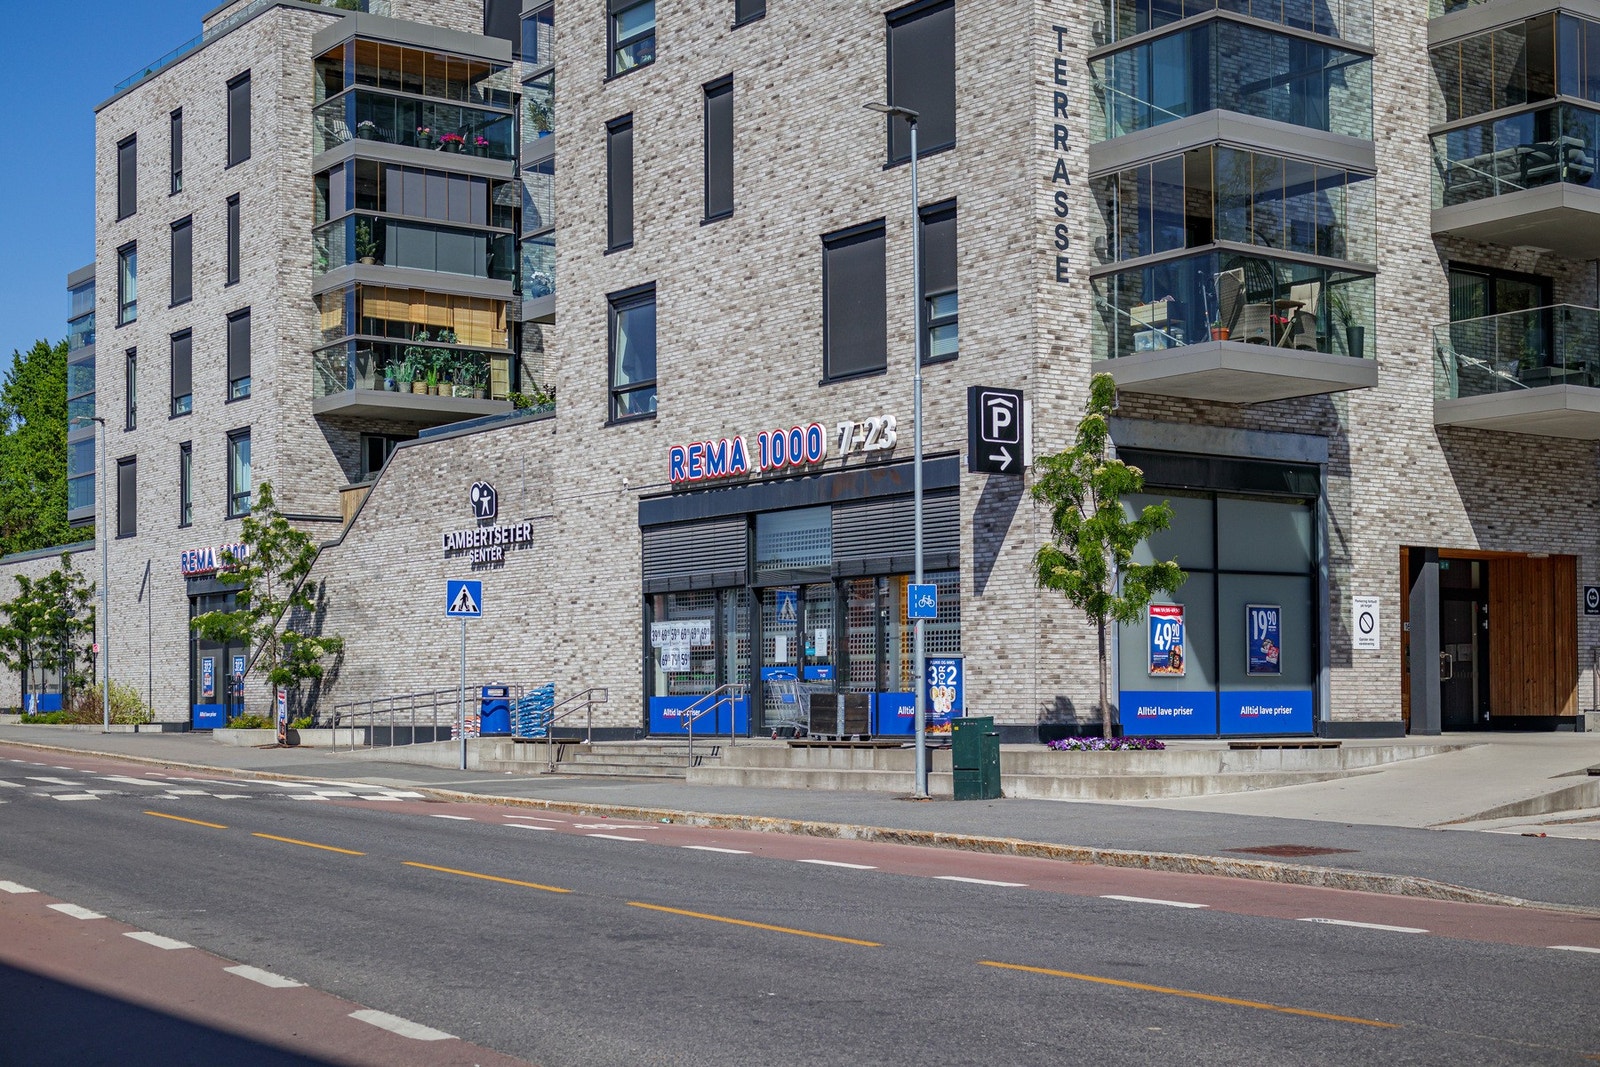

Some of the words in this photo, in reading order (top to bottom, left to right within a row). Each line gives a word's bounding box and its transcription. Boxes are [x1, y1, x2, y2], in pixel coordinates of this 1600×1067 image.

[1051, 25, 1071, 284] TERRASSE
[992, 406, 1012, 438] P
[669, 435, 749, 483] REMA
[757, 422, 827, 471] 1000
[836, 414, 898, 458] 7-23
[442, 522, 533, 551] LAMBERTSETER
[181, 546, 217, 576] REMA
[469, 546, 503, 563] SENTER
[1154, 623, 1172, 651] 49
[1171, 623, 1180, 637] 90
[1252, 610, 1267, 640] 19
[1267, 610, 1277, 626] 90
[928, 665, 938, 685] 3
[938, 665, 946, 685] FOR
[946, 665, 957, 685] 2
[663, 708, 676, 716] Alltid
[898, 705, 915, 715] Alltid
[1137, 706, 1157, 716] Alltid
[1158, 706, 1172, 716] lave
[1173, 707, 1193, 717] priser
[1240, 705, 1259, 715] Alltid
[1259, 705, 1273, 715] lave
[1273, 706, 1293, 716] priser
